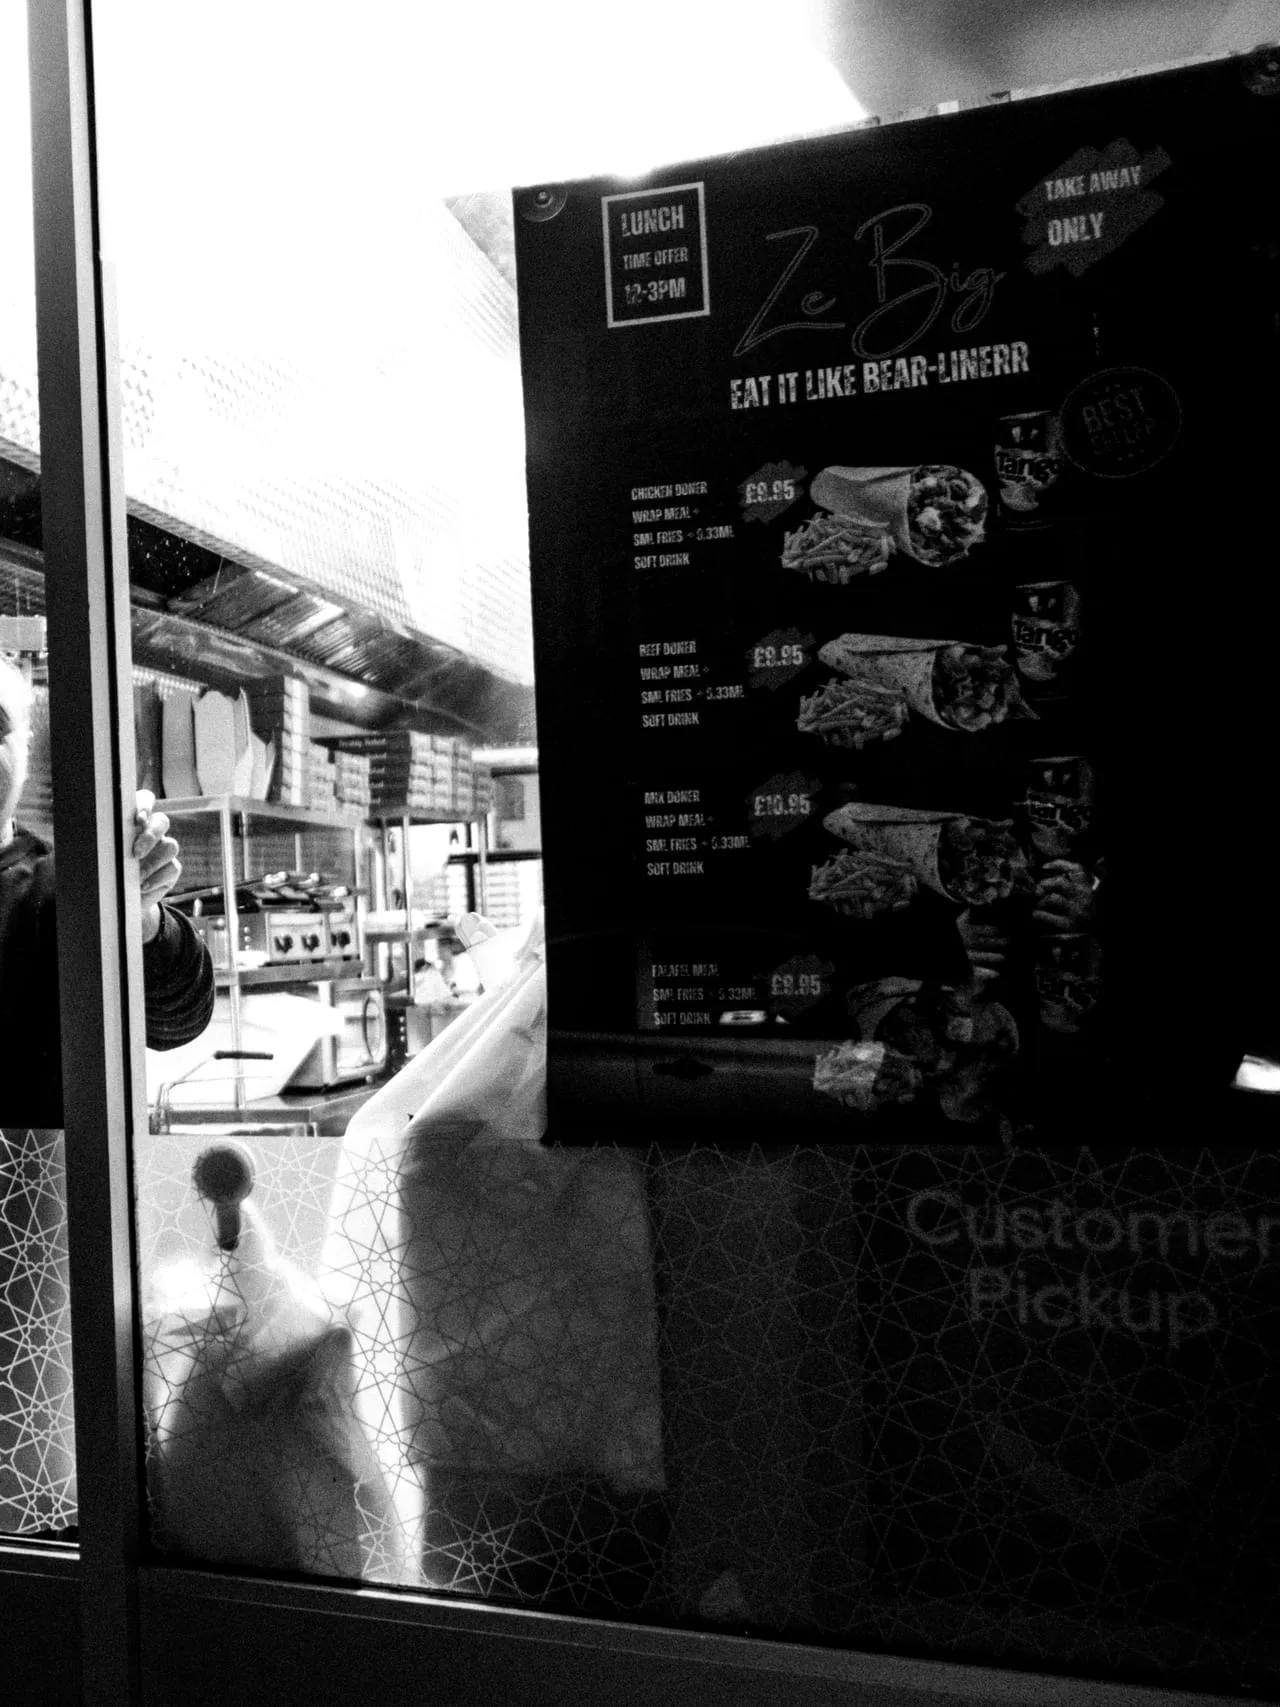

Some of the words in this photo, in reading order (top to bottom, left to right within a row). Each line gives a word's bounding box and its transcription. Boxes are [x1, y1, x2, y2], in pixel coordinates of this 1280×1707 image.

[1044, 175, 1086, 201] TAKE
[1089, 165, 1142, 193] AWAY
[621, 204, 685, 238] LUNCH
[1047, 212, 1104, 246] ONLY
[622, 251, 652, 270] TIME
[654, 246, 688, 265] OFFER
[624, 276, 686, 304] 12-3PM
[732, 225, 846, 358] Ze
[852, 203, 1007, 360] Big
[730, 375, 772, 410] EAT
[777, 371, 800, 405] IT
[805, 364, 858, 401] LIKE
[862, 340, 1031, 394] BEAR-LINERR
[631, 484, 673, 501] CHICKEN
[675, 481, 708, 497] DONER
[632, 508, 663, 524] WRAP
[664, 506, 692, 521] MEAL
[657, 530, 684, 545] FRIES
[634, 555, 658, 569] SOFT
[659, 552, 691, 567] DRINK
[639, 642, 662, 657] BEEF
[663, 640, 696, 656] DONER
[640, 666, 672, 680] WRAP
[673, 664, 701, 679] MEAL
[665, 688, 693, 703] FRIES
[642, 713, 666, 728] SOFT
[668, 712, 700, 726] DRINK
[644, 791, 665, 805] MIX
[667, 789, 700, 804] DONER
[753, 792, 812, 817] £10.95
[644, 814, 676, 828] WRAP
[678, 813, 706, 828] MEAL
[670, 836, 697, 851] FRIES
[646, 861, 671, 876] SOFT
[672, 860, 704, 875] DRINK
[677, 987, 704, 1001] FRIES
[654, 1011, 677, 1025] SOFT
[679, 1011, 711, 1025] DRINK
[905, 1189, 1280, 1260] Customer
[969, 1266, 1221, 1350] Pickup
